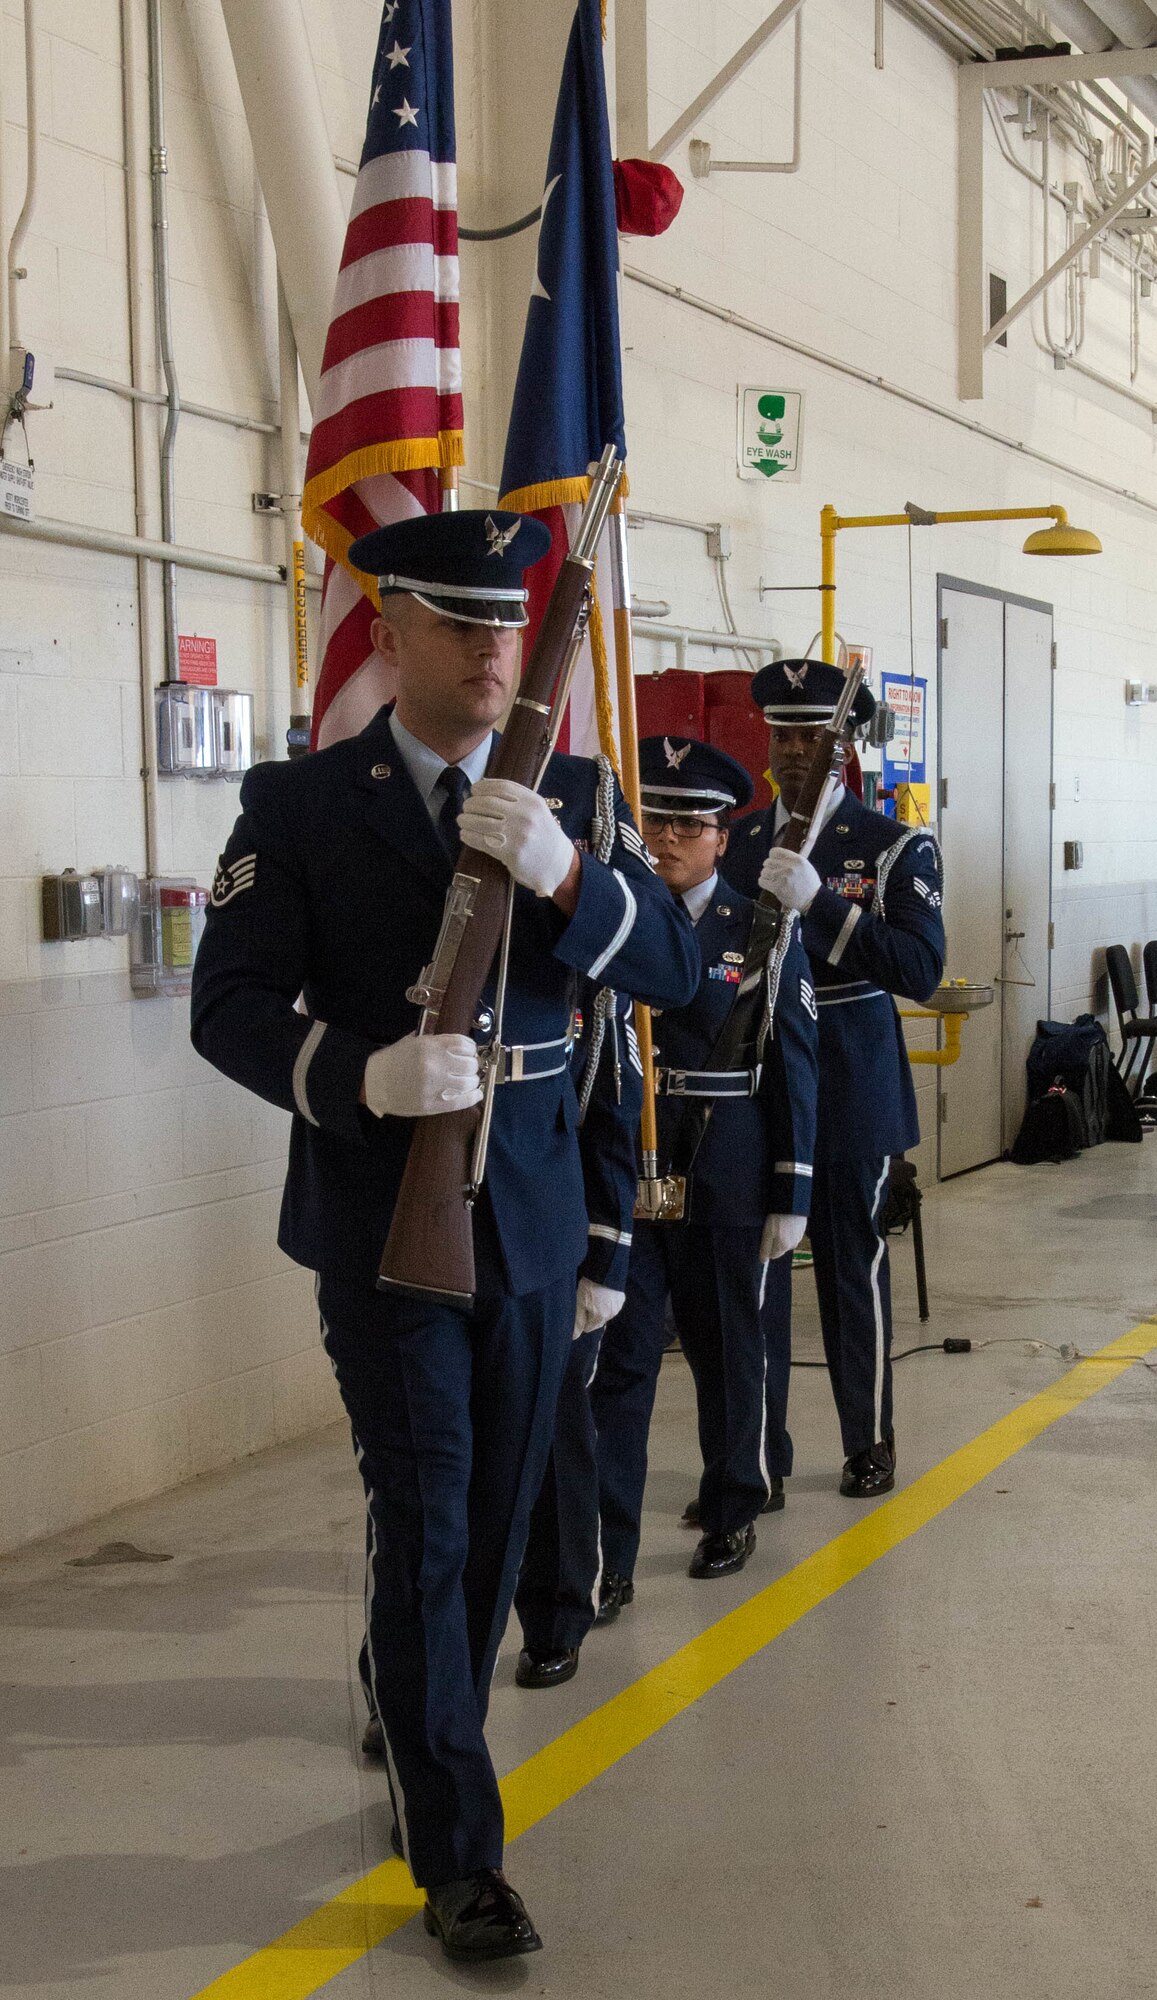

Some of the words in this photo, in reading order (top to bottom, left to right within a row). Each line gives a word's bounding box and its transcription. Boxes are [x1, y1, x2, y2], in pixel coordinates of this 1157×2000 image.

[747, 447, 763, 457] EYE
[766, 449, 792, 459] WASH
[888, 687, 901, 701] RIGHT
